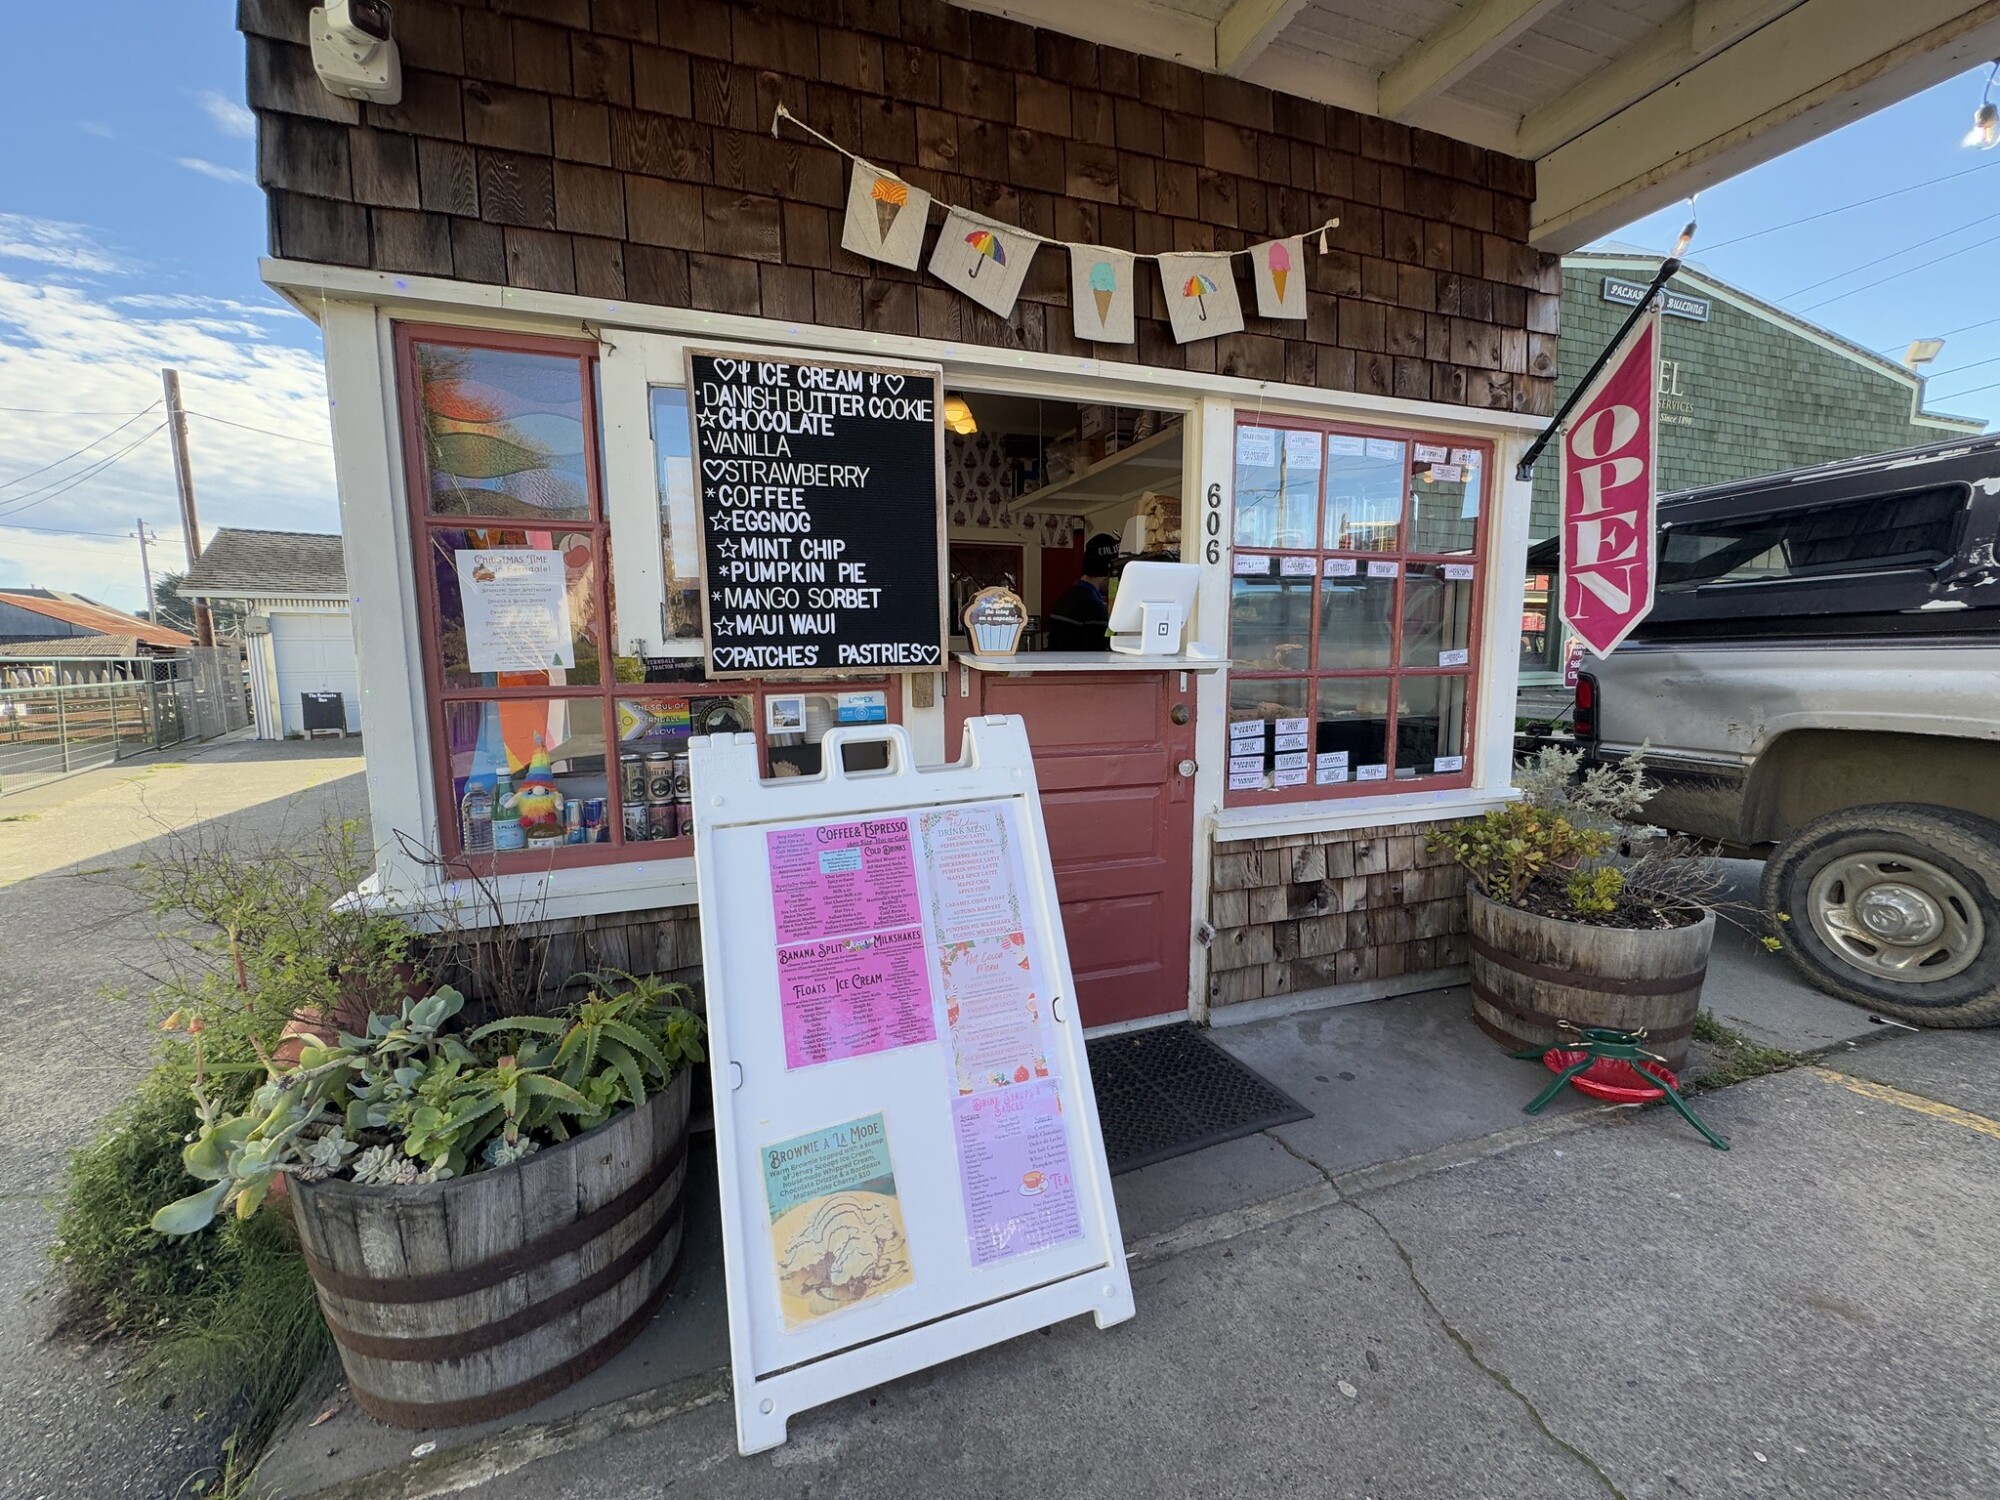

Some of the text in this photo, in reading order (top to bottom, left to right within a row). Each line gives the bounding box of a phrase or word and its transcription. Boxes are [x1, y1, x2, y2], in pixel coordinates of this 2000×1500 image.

[1667, 298, 1704, 315] BUILDING
[758, 362, 863, 393] ICE CREAM
[703, 382, 934, 422] DANISH BUTTER COOKIE
[718, 406, 835, 437] CHOCOLATE
[1660, 412, 1678, 424] Since
[706, 430, 792, 458] VANILLA
[725, 460, 870, 488] STRAWBERRY
[718, 485, 806, 510] COFFEE
[732, 510, 811, 533] EGGNOG
[1206, 482, 1222, 565] 606
[1569, 404, 1644, 620] OPEN
[474, 554, 548, 564] CHRISTMAS TIME
[741, 537, 846, 560] MINT CHIP
[731, 561, 867, 584] PUMPKIN PIE
[724, 587, 882, 610] MANGO SORBET
[736, 612, 836, 636] MAUI WAUI
[734, 643, 923, 668] PATCHES' PASTRIES
[650, 703, 673, 711] SOUL
[653, 728, 676, 736] LOVE
[861, 821, 907, 839] ESPRESSO
[938, 824, 991, 838] DRINK MENU
[864, 846, 882, 857] COLD
[873, 930, 921, 949] MILKSHAKES
[778, 943, 843, 965] BANANA SPLIT
[792, 983, 826, 999] FLOATS
[835, 973, 883, 993] ICE CREAM
[972, 1090, 1033, 1112] DRINK SYRUPS
[994, 1100, 1024, 1118] SAUCES
[768, 1123, 880, 1169] BROWNIE A LA MODE
[769, 1168, 790, 1178] Warm
[790, 1158, 818, 1171] Brownie
[819, 1149, 844, 1162] topped
[864, 1138, 884, 1148] scoop
[791, 1167, 814, 1177] Jersey
[814, 1159, 839, 1171] Scoops
[780, 1182, 815, 1197] Chocolate
[815, 1173, 838, 1186] Drizzle
[850, 1160, 881, 1173] Bordeaux
[782, 1173, 822, 1189] housemade
[822, 1162, 852, 1176] Whipped
[793, 1182, 832, 1201] Maraschino
[858, 1170, 871, 1179] $10
[1049, 1172, 1069, 1189] TEA
